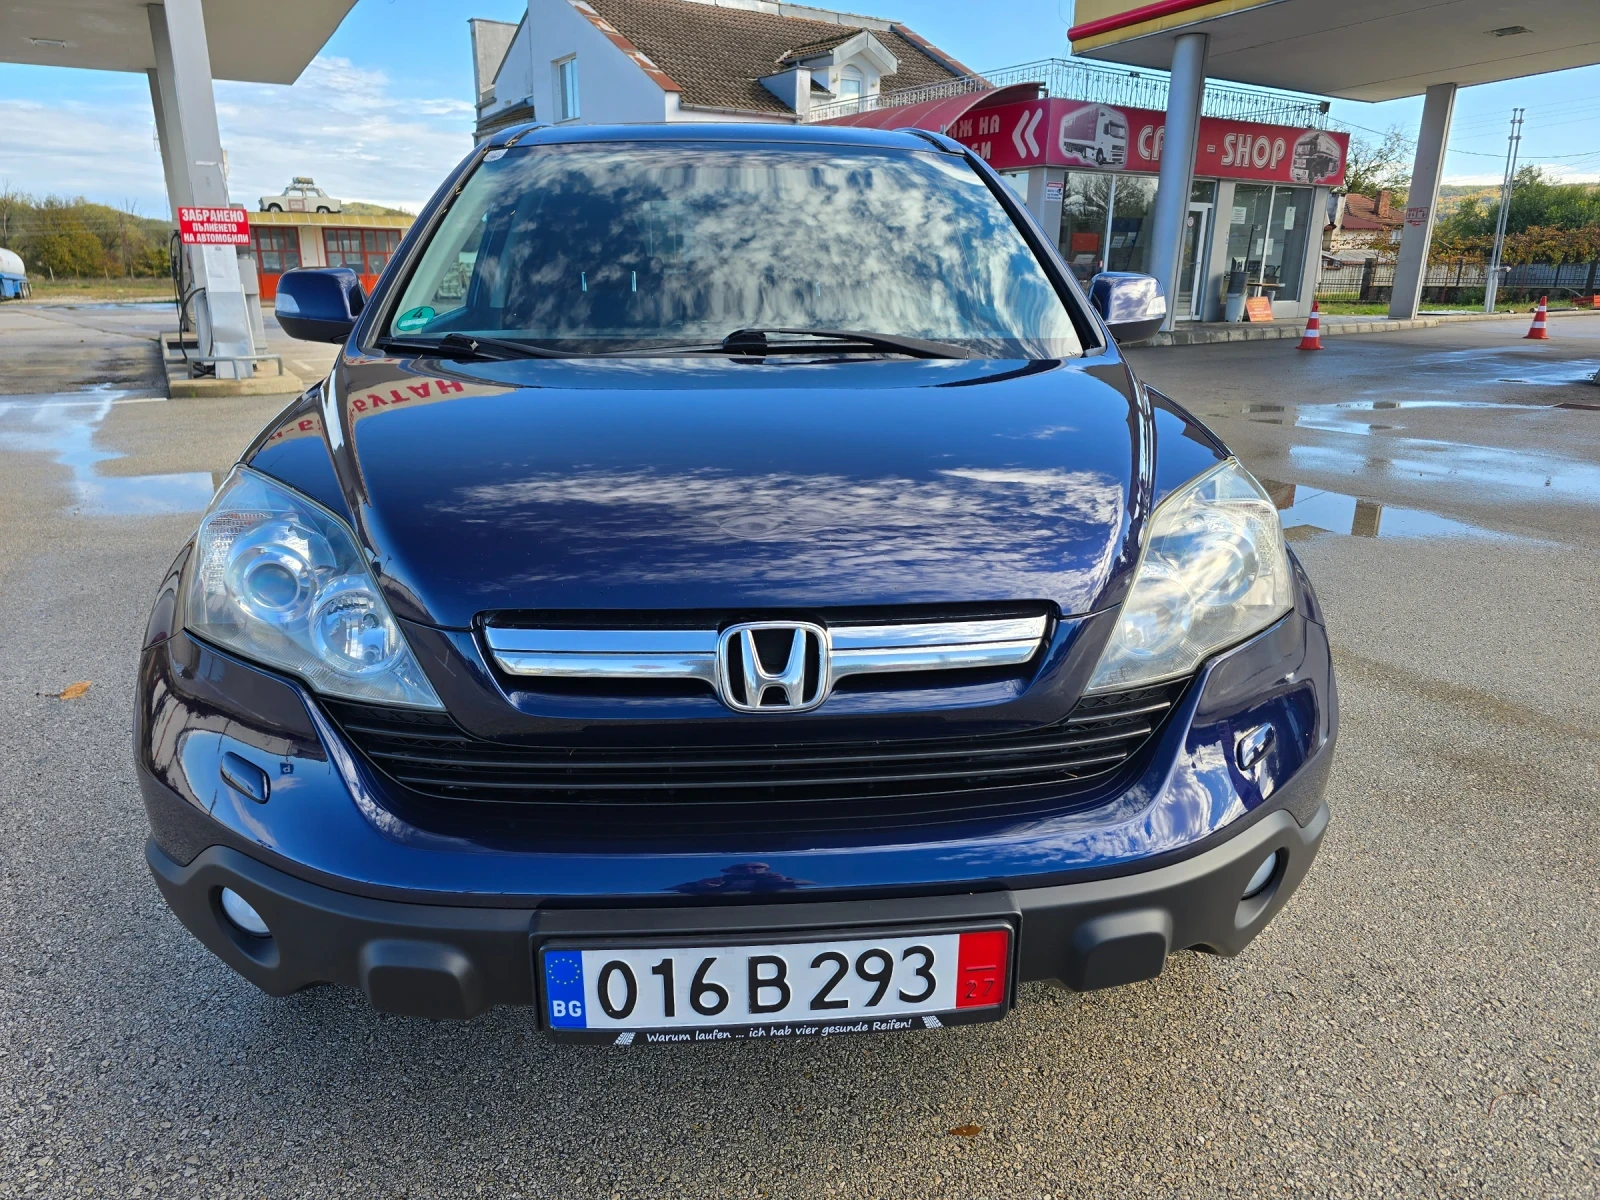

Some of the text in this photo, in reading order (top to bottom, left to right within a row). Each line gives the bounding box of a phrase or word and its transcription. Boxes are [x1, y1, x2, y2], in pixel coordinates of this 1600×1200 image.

[948, 114, 1000, 138] АЖ НА
[1221, 132, 1286, 169] SHOP
[181, 208, 244, 222] ЗАБРАНЕНО
[192, 222, 238, 233] ПЪЛНЕНЕТО
[183, 232, 249, 243] НА АВТОМОБИЛИ
[412, 307, 423, 318] 4
[597, 945, 937, 1019] 016 B 293
[964, 978, 995, 999] 27
[553, 1000, 582, 1017] BG
[647, 1033, 691, 1042] Warum
[695, 1029, 731, 1041] laufen
[749, 1027, 766, 1038] ich
[770, 1026, 792, 1036] hab
[795, 1025, 818, 1035] vier
[821, 1022, 868, 1036] gesunde
[873, 1019, 912, 1031] Reifen!
